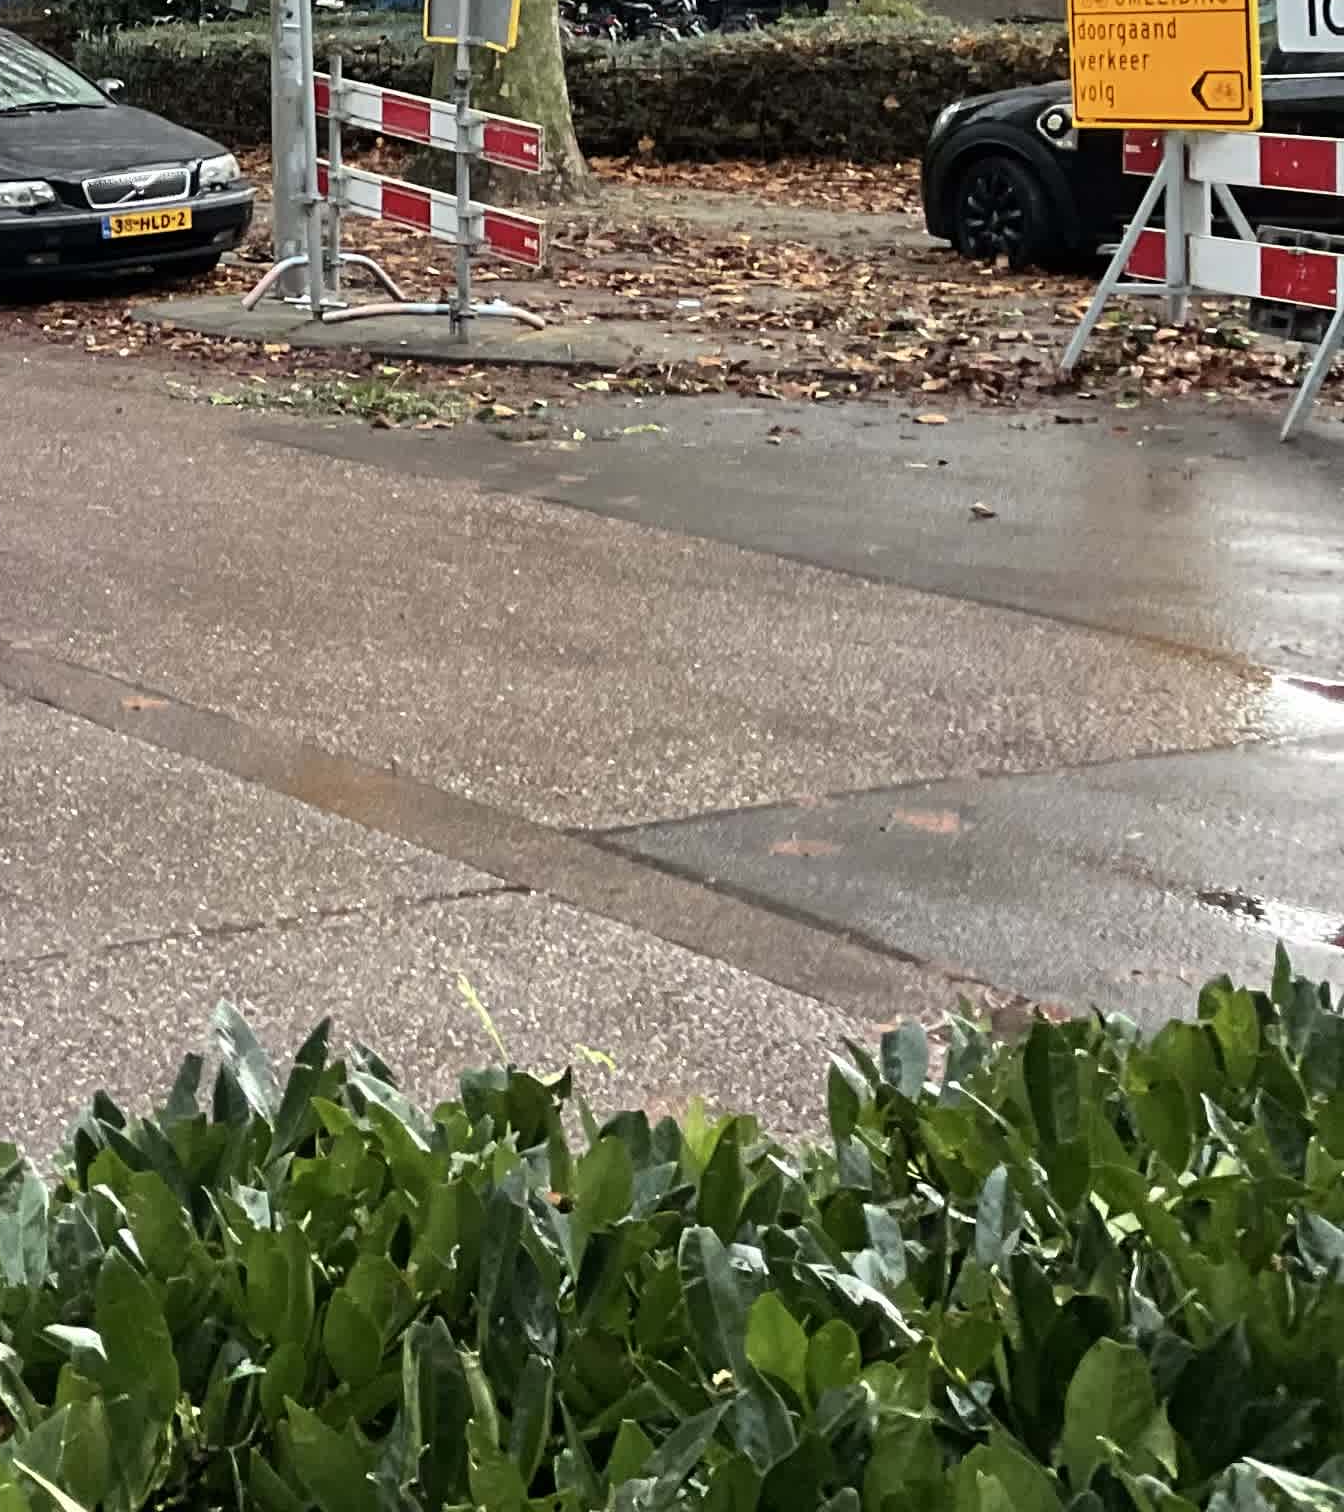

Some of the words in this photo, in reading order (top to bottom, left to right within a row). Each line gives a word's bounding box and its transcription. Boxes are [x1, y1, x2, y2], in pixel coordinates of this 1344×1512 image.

[1077, 16, 1177, 47] doorgaand
[1079, 48, 1151, 72] verkeer
[1079, 79, 1115, 109] volg
